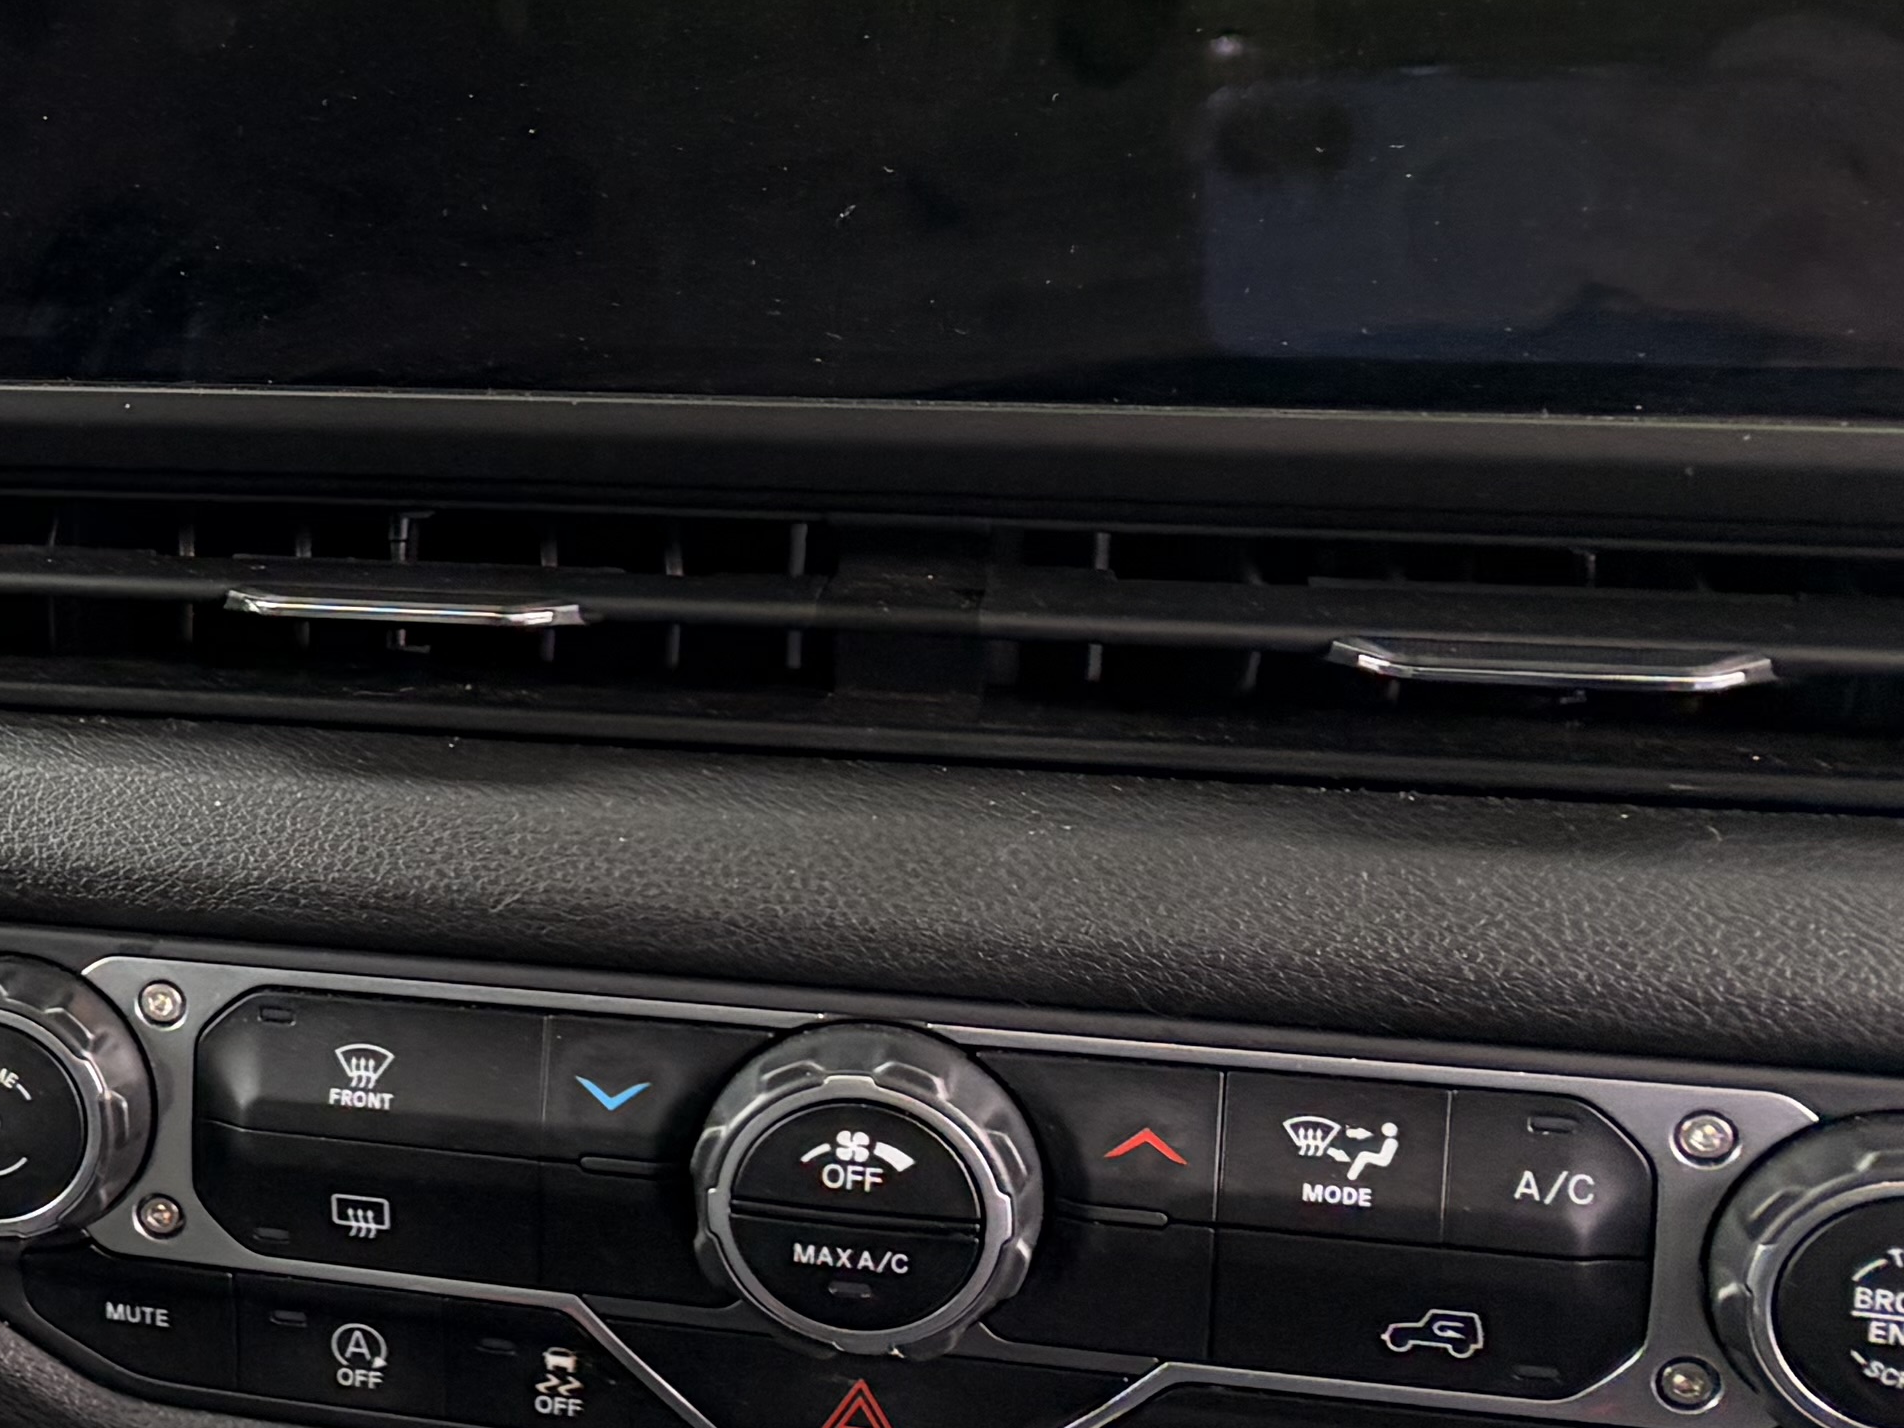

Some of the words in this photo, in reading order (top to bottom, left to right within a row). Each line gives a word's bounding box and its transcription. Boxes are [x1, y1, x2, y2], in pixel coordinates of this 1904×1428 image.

[328, 1087, 394, 1112] FRONT
[821, 1164, 884, 1193] OFF
[1514, 1170, 1595, 1206] A/C
[1302, 1183, 1372, 1208] MODE
[792, 1243, 856, 1271] MAX
[857, 1248, 910, 1276] A/C
[105, 1301, 171, 1329] MUTE
[336, 1367, 384, 1390] OFF
[534, 1394, 584, 1419] OFF
